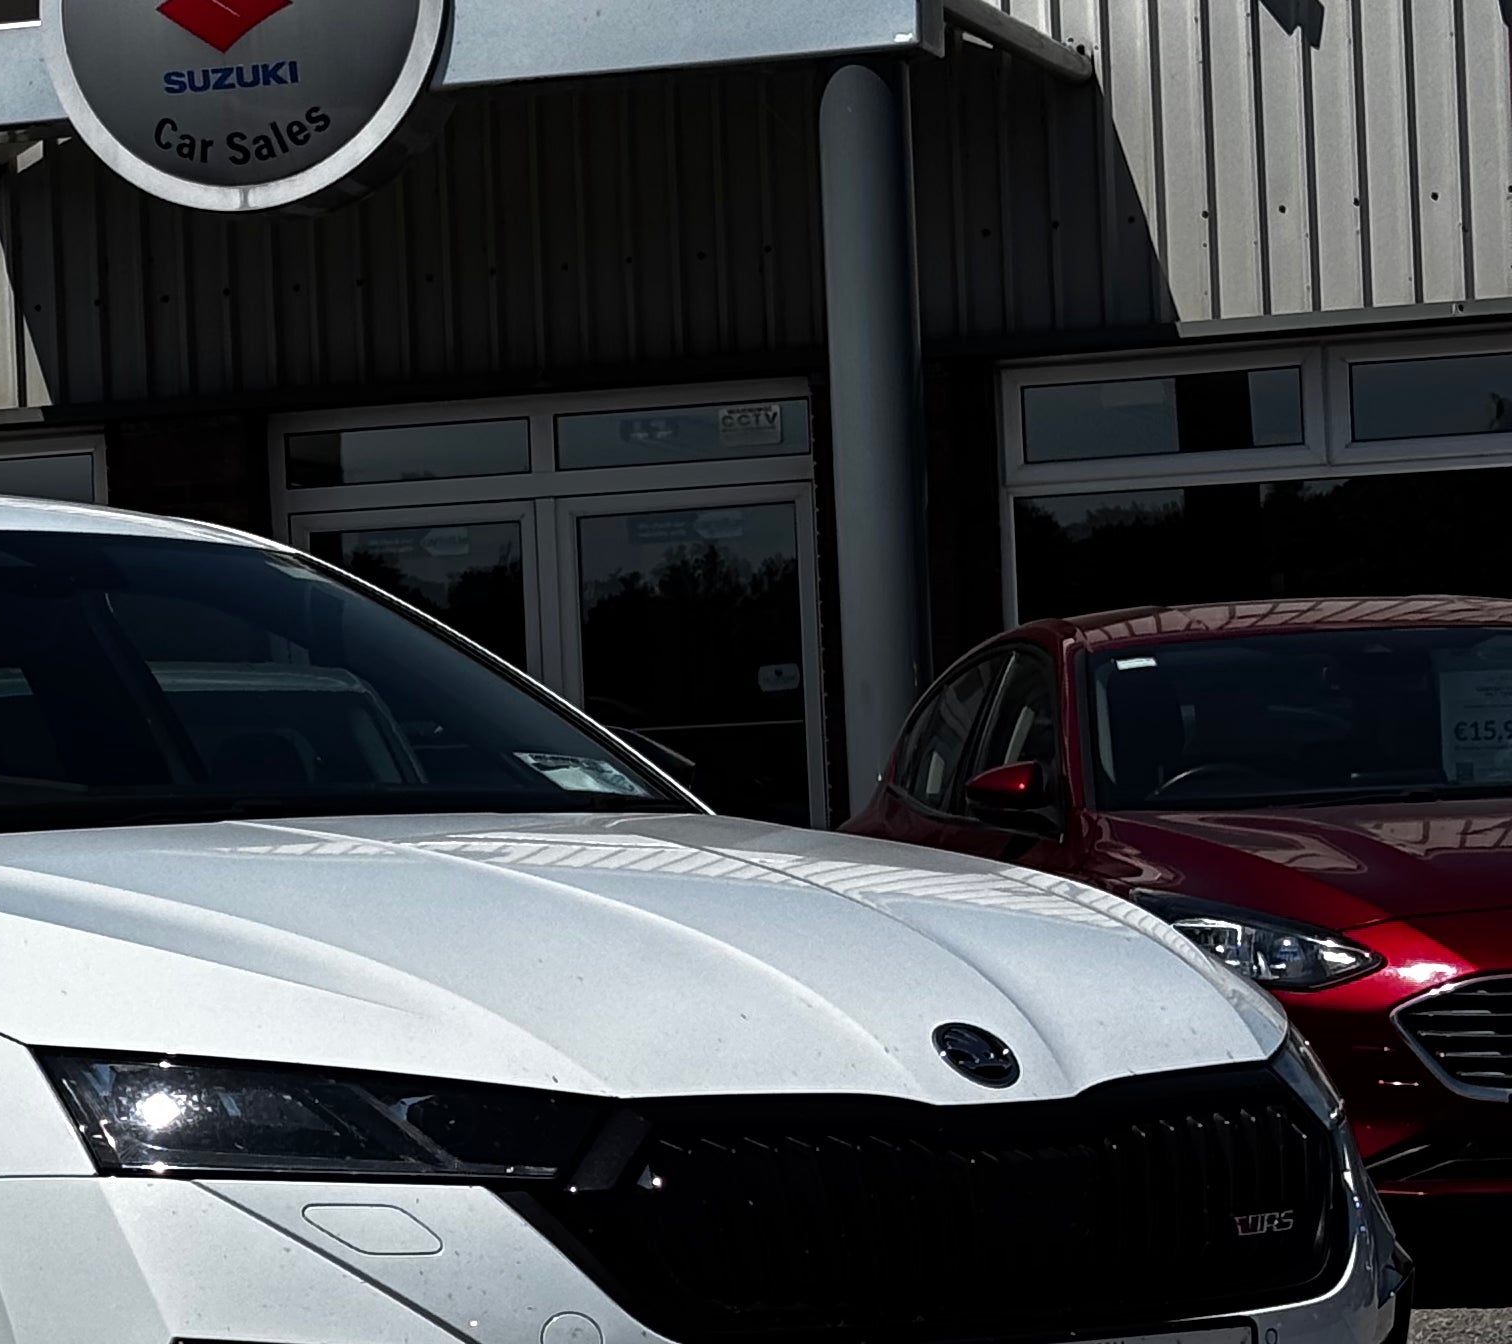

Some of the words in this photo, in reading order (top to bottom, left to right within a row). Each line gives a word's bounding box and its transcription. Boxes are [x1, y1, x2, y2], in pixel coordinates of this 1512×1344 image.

[163, 61, 300, 94] SUZUKI
[154, 117, 214, 164] Car
[228, 105, 332, 166] Sales
[721, 411, 778, 428] CCTV
